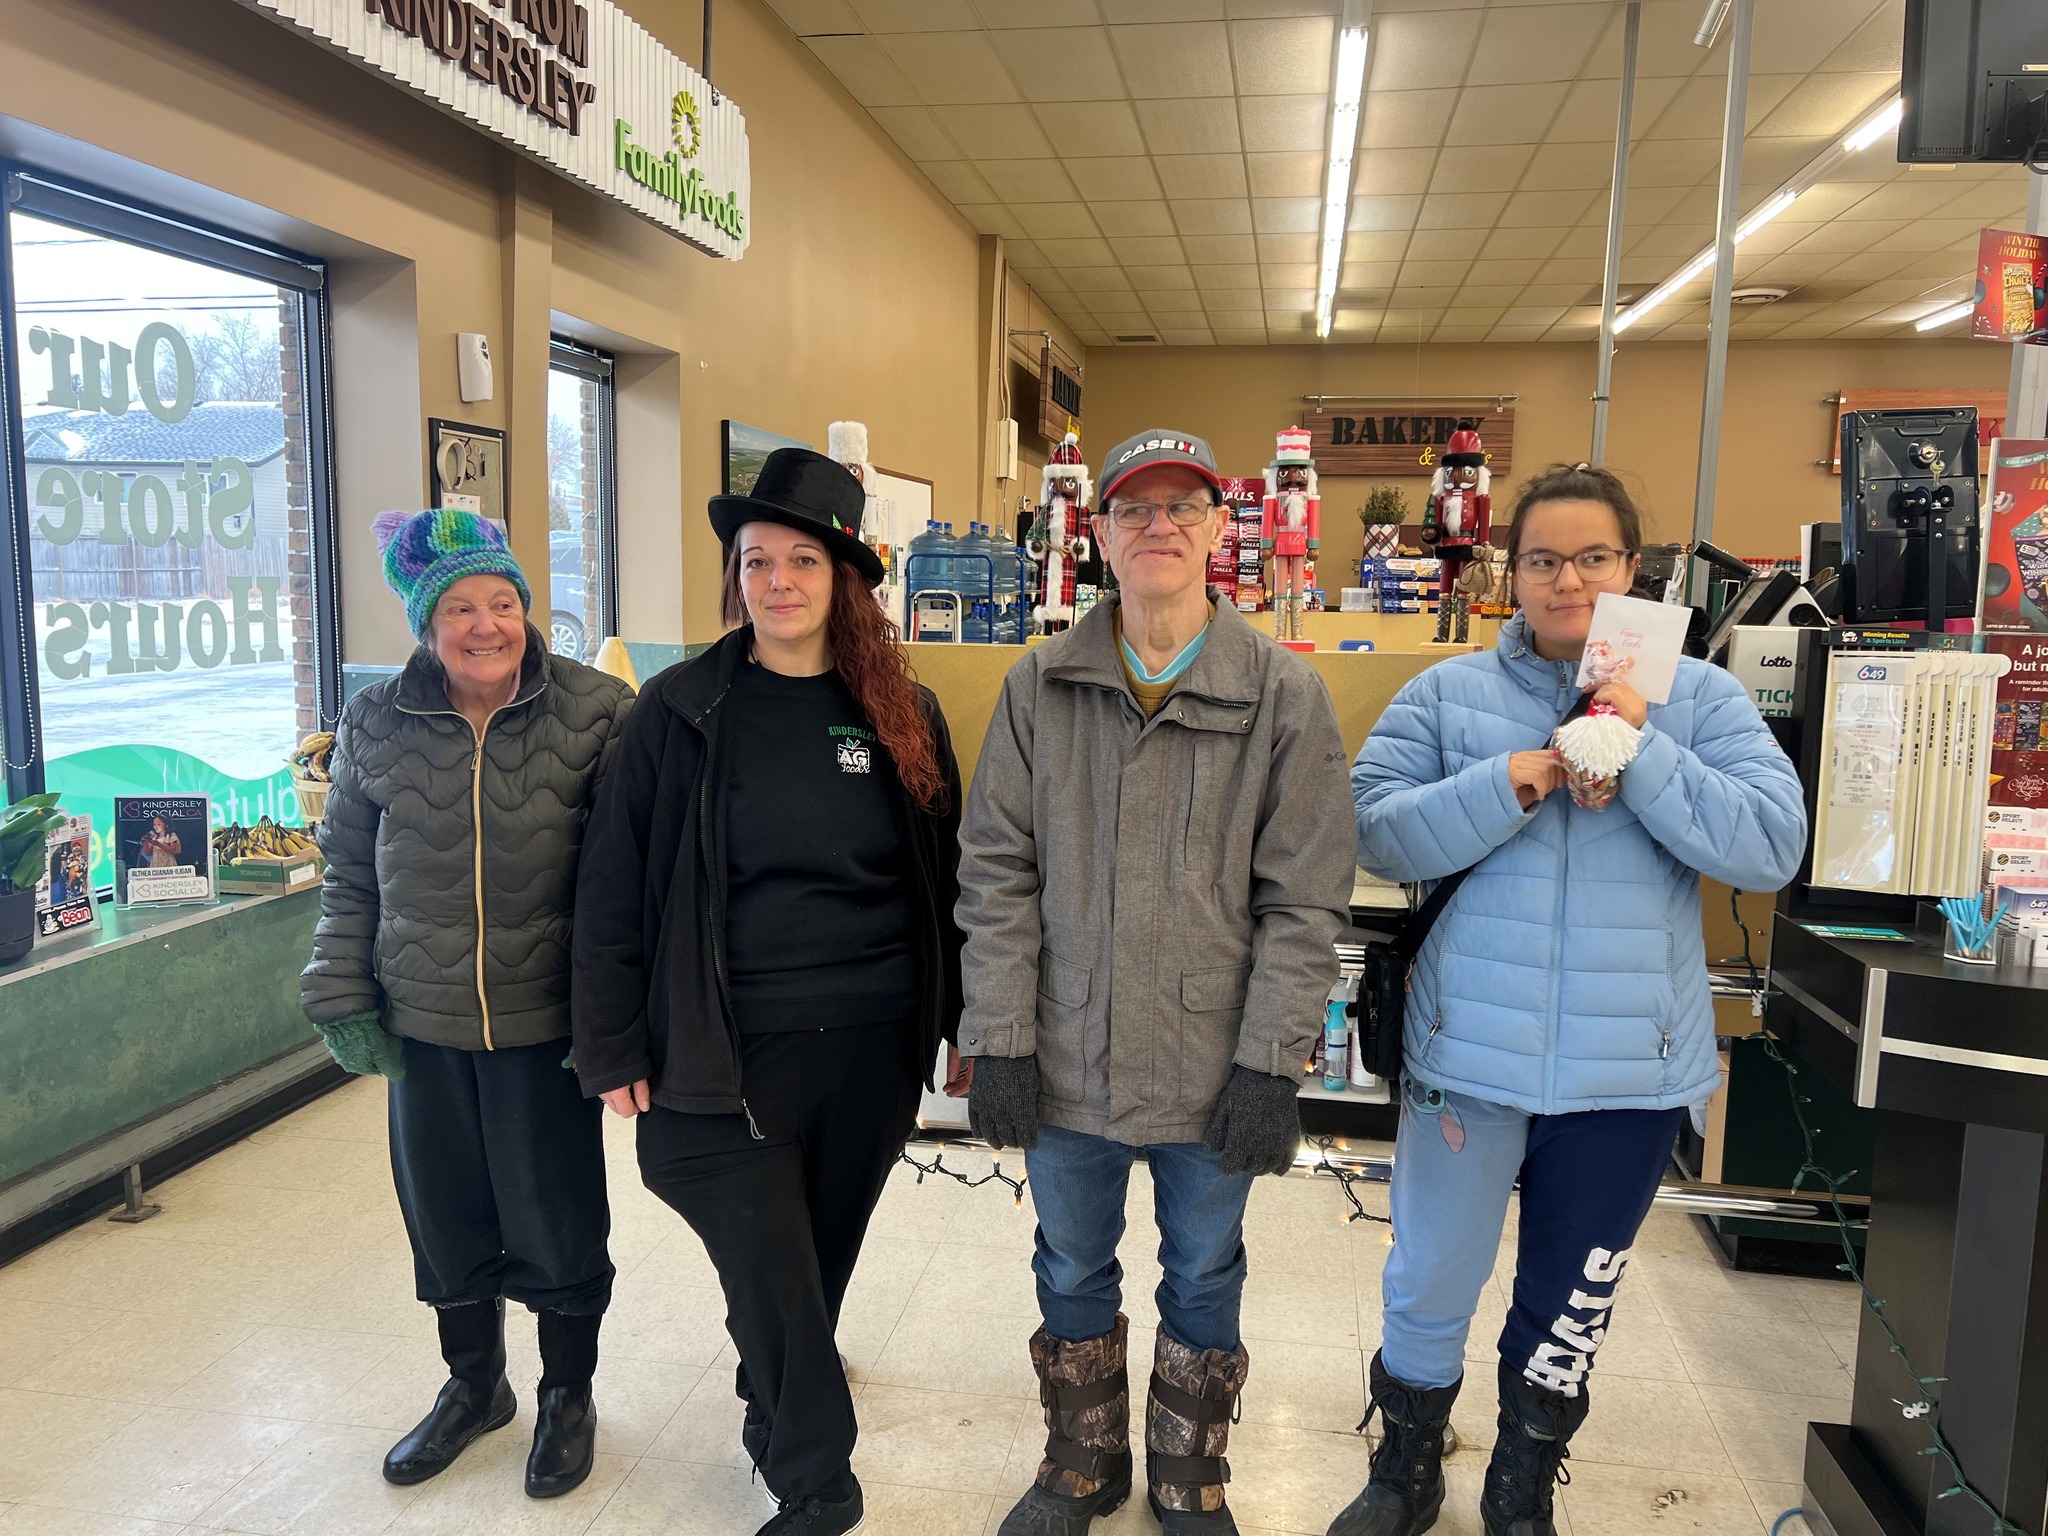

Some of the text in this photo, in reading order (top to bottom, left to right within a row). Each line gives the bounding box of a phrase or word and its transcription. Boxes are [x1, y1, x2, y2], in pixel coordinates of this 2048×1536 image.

[489, 0, 588, 68] ROM
[2003, 235, 2023, 245] WIN
[1118, 439, 1177, 465] CASE
[1419, 447, 1436, 465] &
[1862, 631, 1887, 639] Winning
[2022, 644, 2033, 655] A
[1760, 656, 1792, 667] Lotto
[2013, 660, 2037, 671] but
[828, 726, 877, 742] KINDERSLEY
[840, 749, 867, 766] AG
[153, 880, 203, 888] KINDERSLEY
[61, 907, 91, 926] Bean
